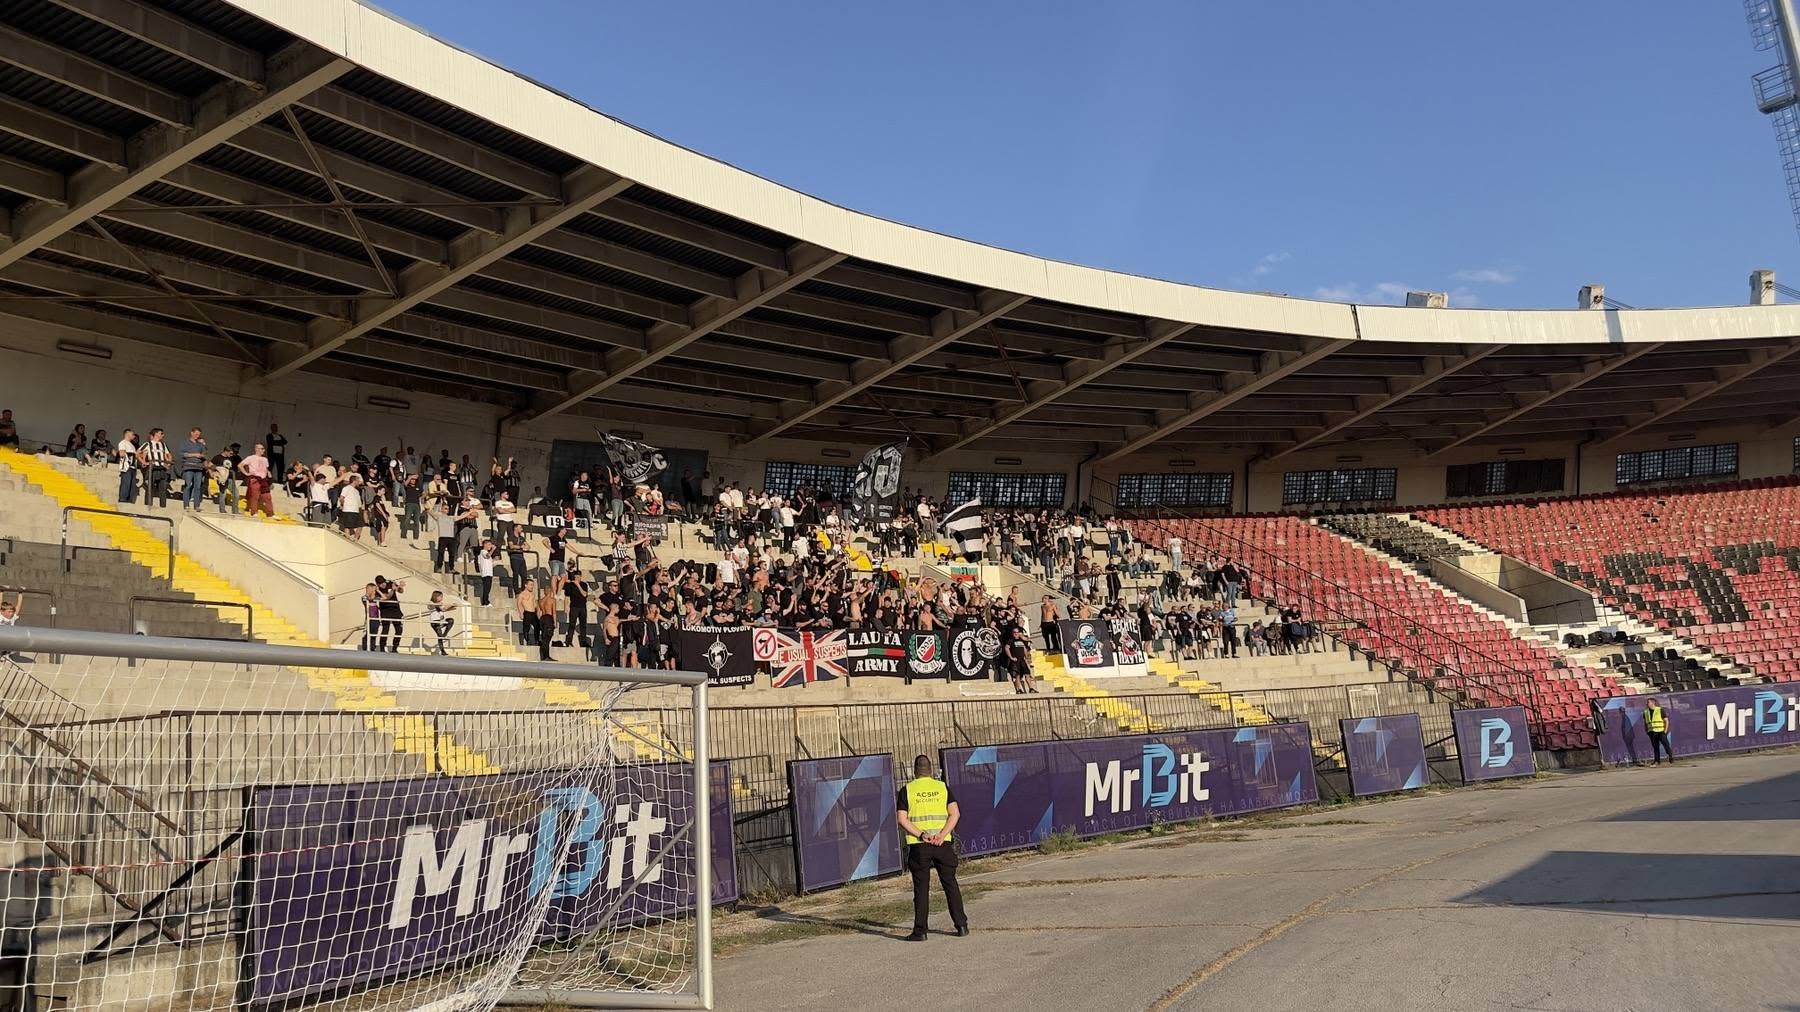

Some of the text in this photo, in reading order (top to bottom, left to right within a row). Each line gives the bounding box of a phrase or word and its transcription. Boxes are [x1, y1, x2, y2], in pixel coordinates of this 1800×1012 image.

[682, 624, 751, 633] LOKOMOTIV PLOVDIV
[854, 658, 900, 672] ARMY
[719, 675, 752, 684] SUSPECTS
[1706, 691, 1800, 740] MrBi
[1085, 743, 1210, 817] MrBit
[1221, 800, 1235, 812] НА
[388, 786, 667, 930] MrBit
